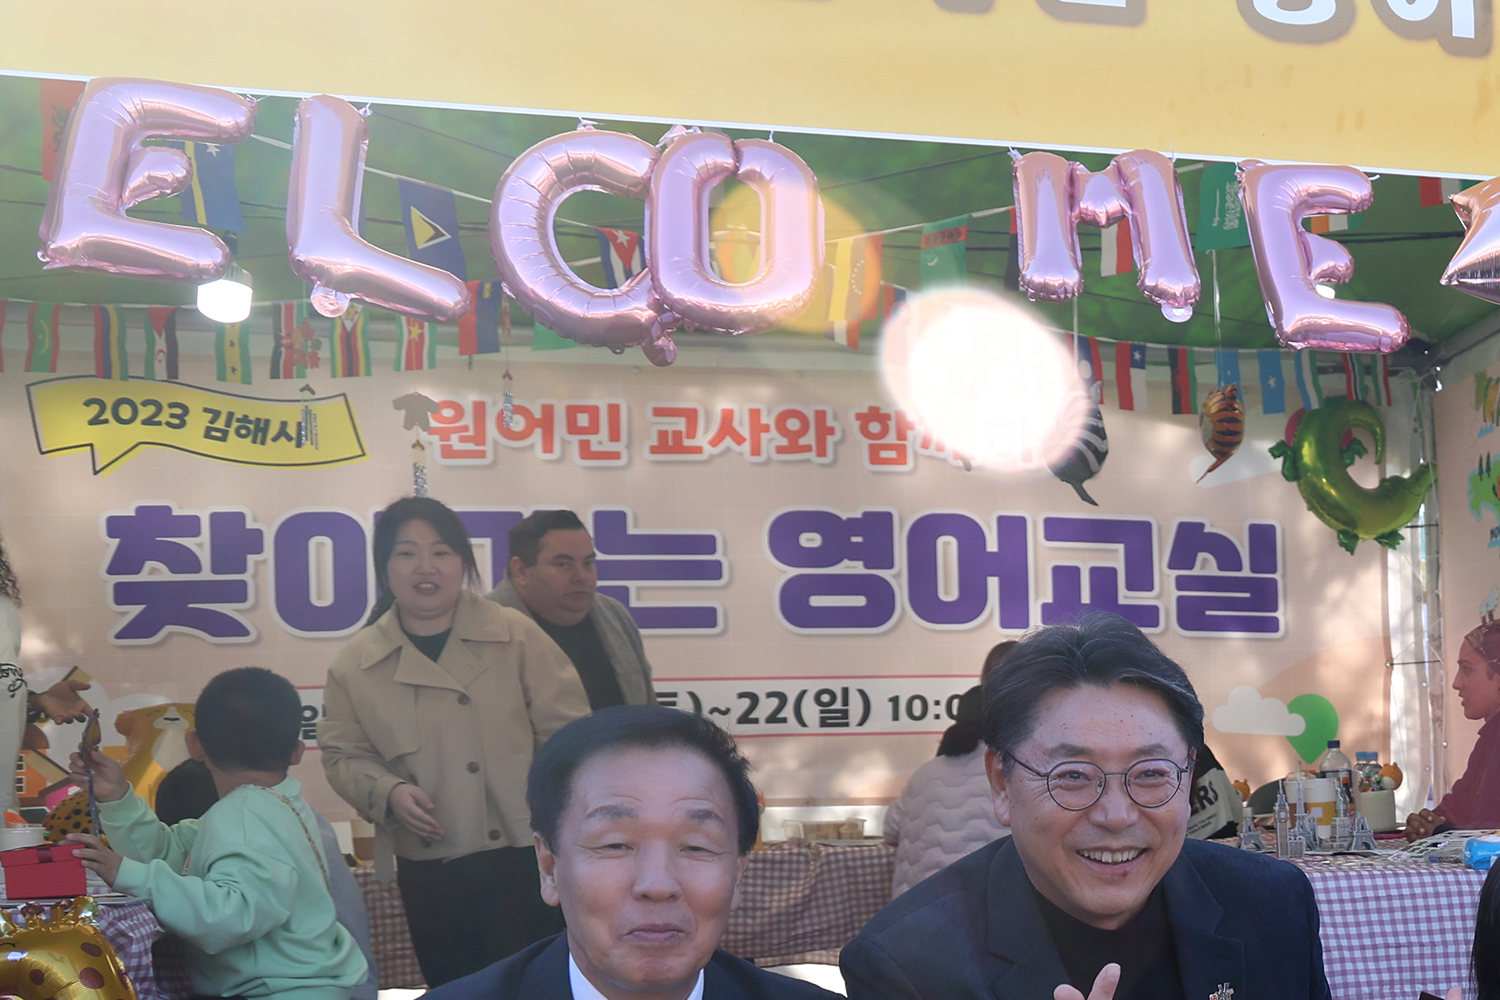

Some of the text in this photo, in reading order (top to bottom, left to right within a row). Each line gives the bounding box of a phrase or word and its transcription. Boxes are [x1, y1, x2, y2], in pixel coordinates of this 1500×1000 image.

[83, 397, 304, 449] 2023 김해시
[427, 399, 622, 461] 원어민
[649, 406, 836, 459] 교사와
[104, 504, 1280, 641] 찾아는 영어교실
